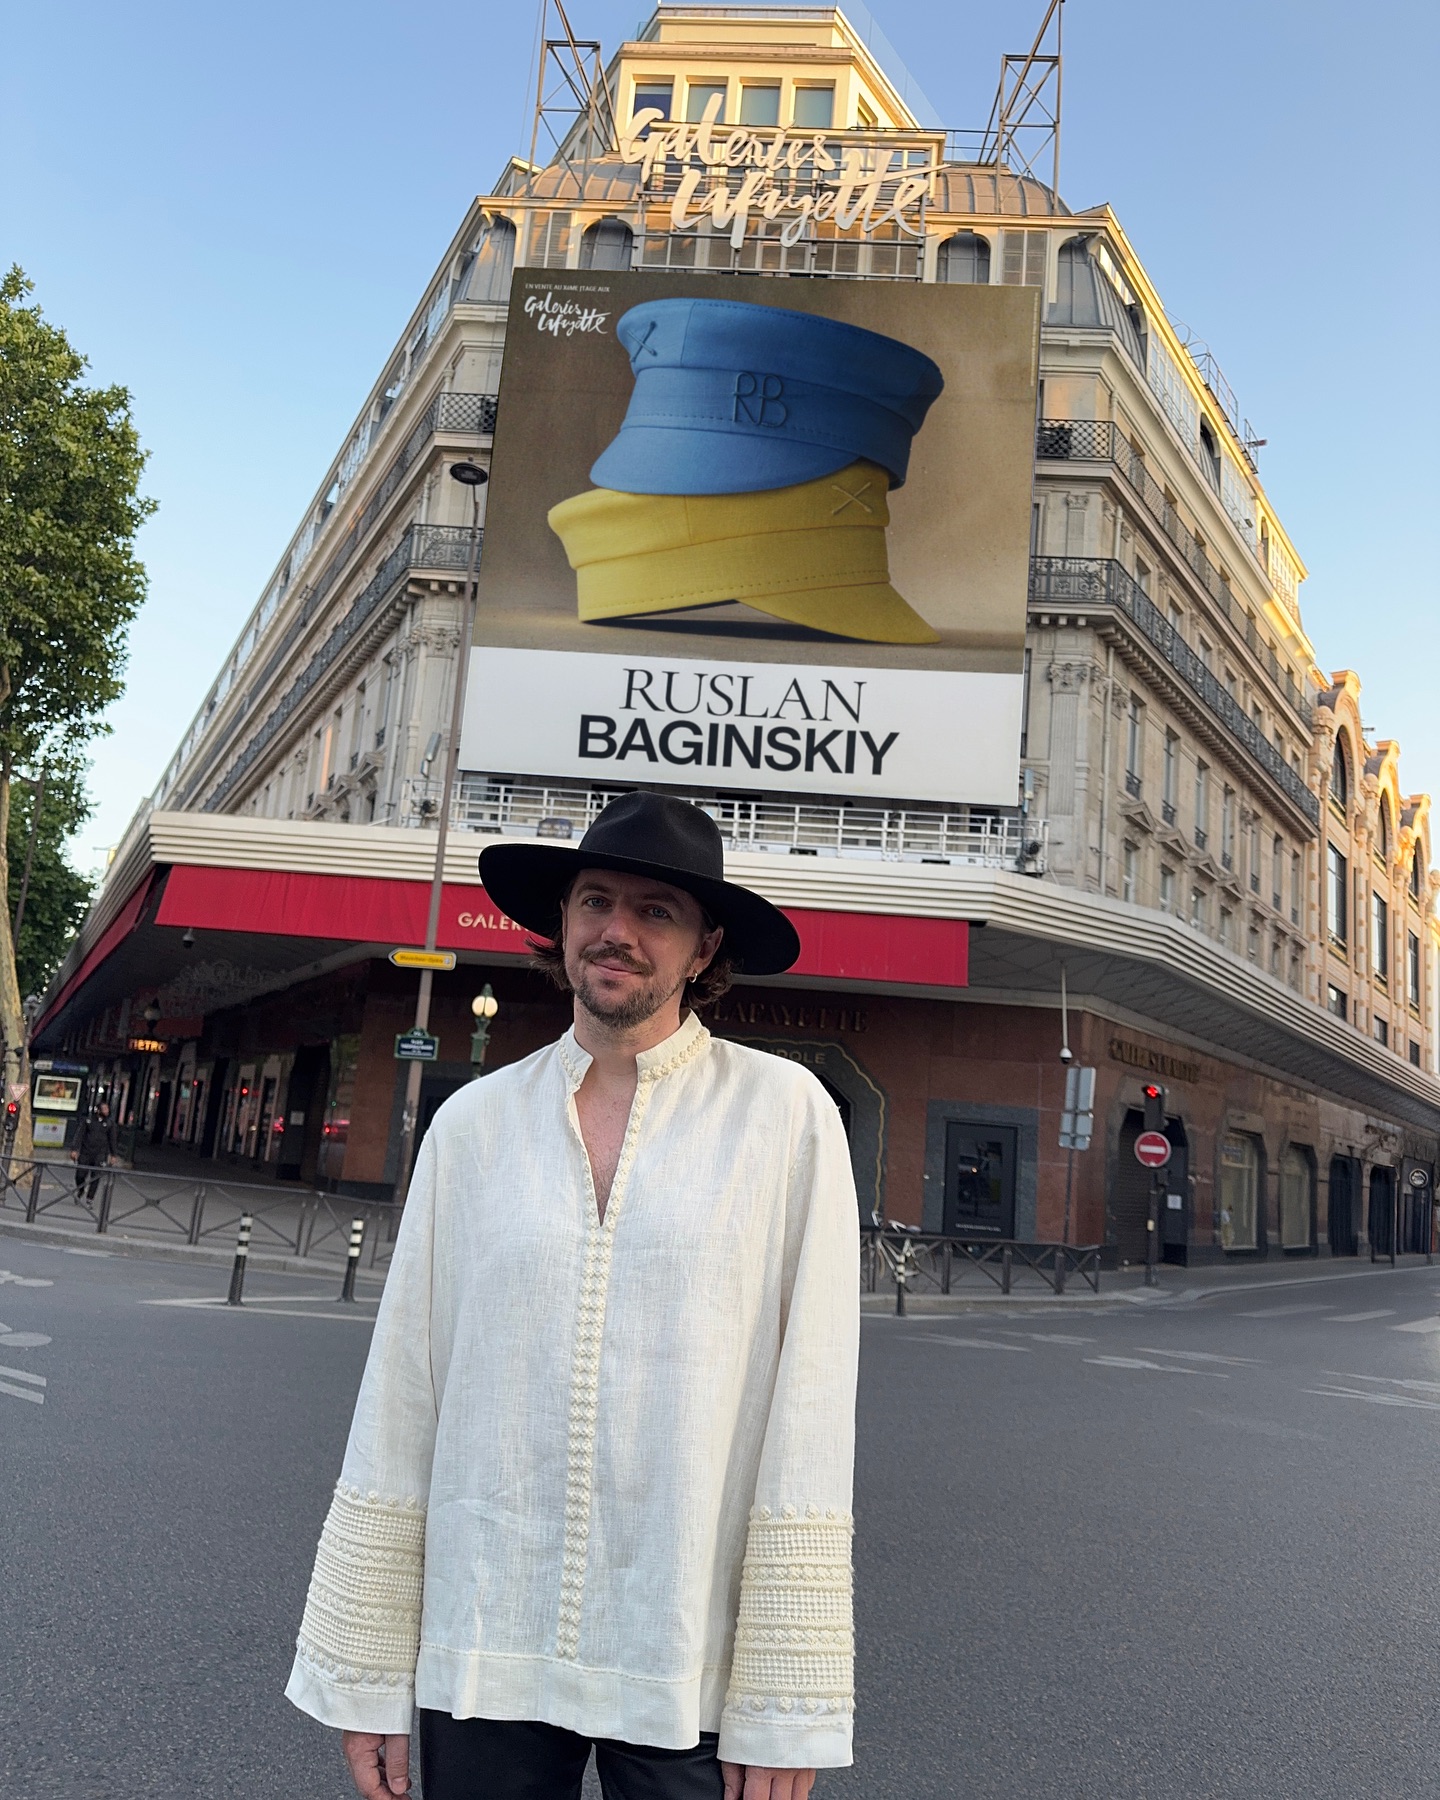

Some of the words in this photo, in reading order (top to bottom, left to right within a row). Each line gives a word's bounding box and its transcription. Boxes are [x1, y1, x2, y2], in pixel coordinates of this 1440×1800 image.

[620, 92, 836, 184] Galeries
[671, 150, 951, 249] Lafayette
[524, 291, 582, 318] Galeries
[537, 308, 612, 337] Lafayette
[732, 371, 788, 428] RB
[619, 668, 867, 724] RUSLAN
[578, 714, 900, 776] BAGINSKIY
[457, 912, 529, 932] GALER
